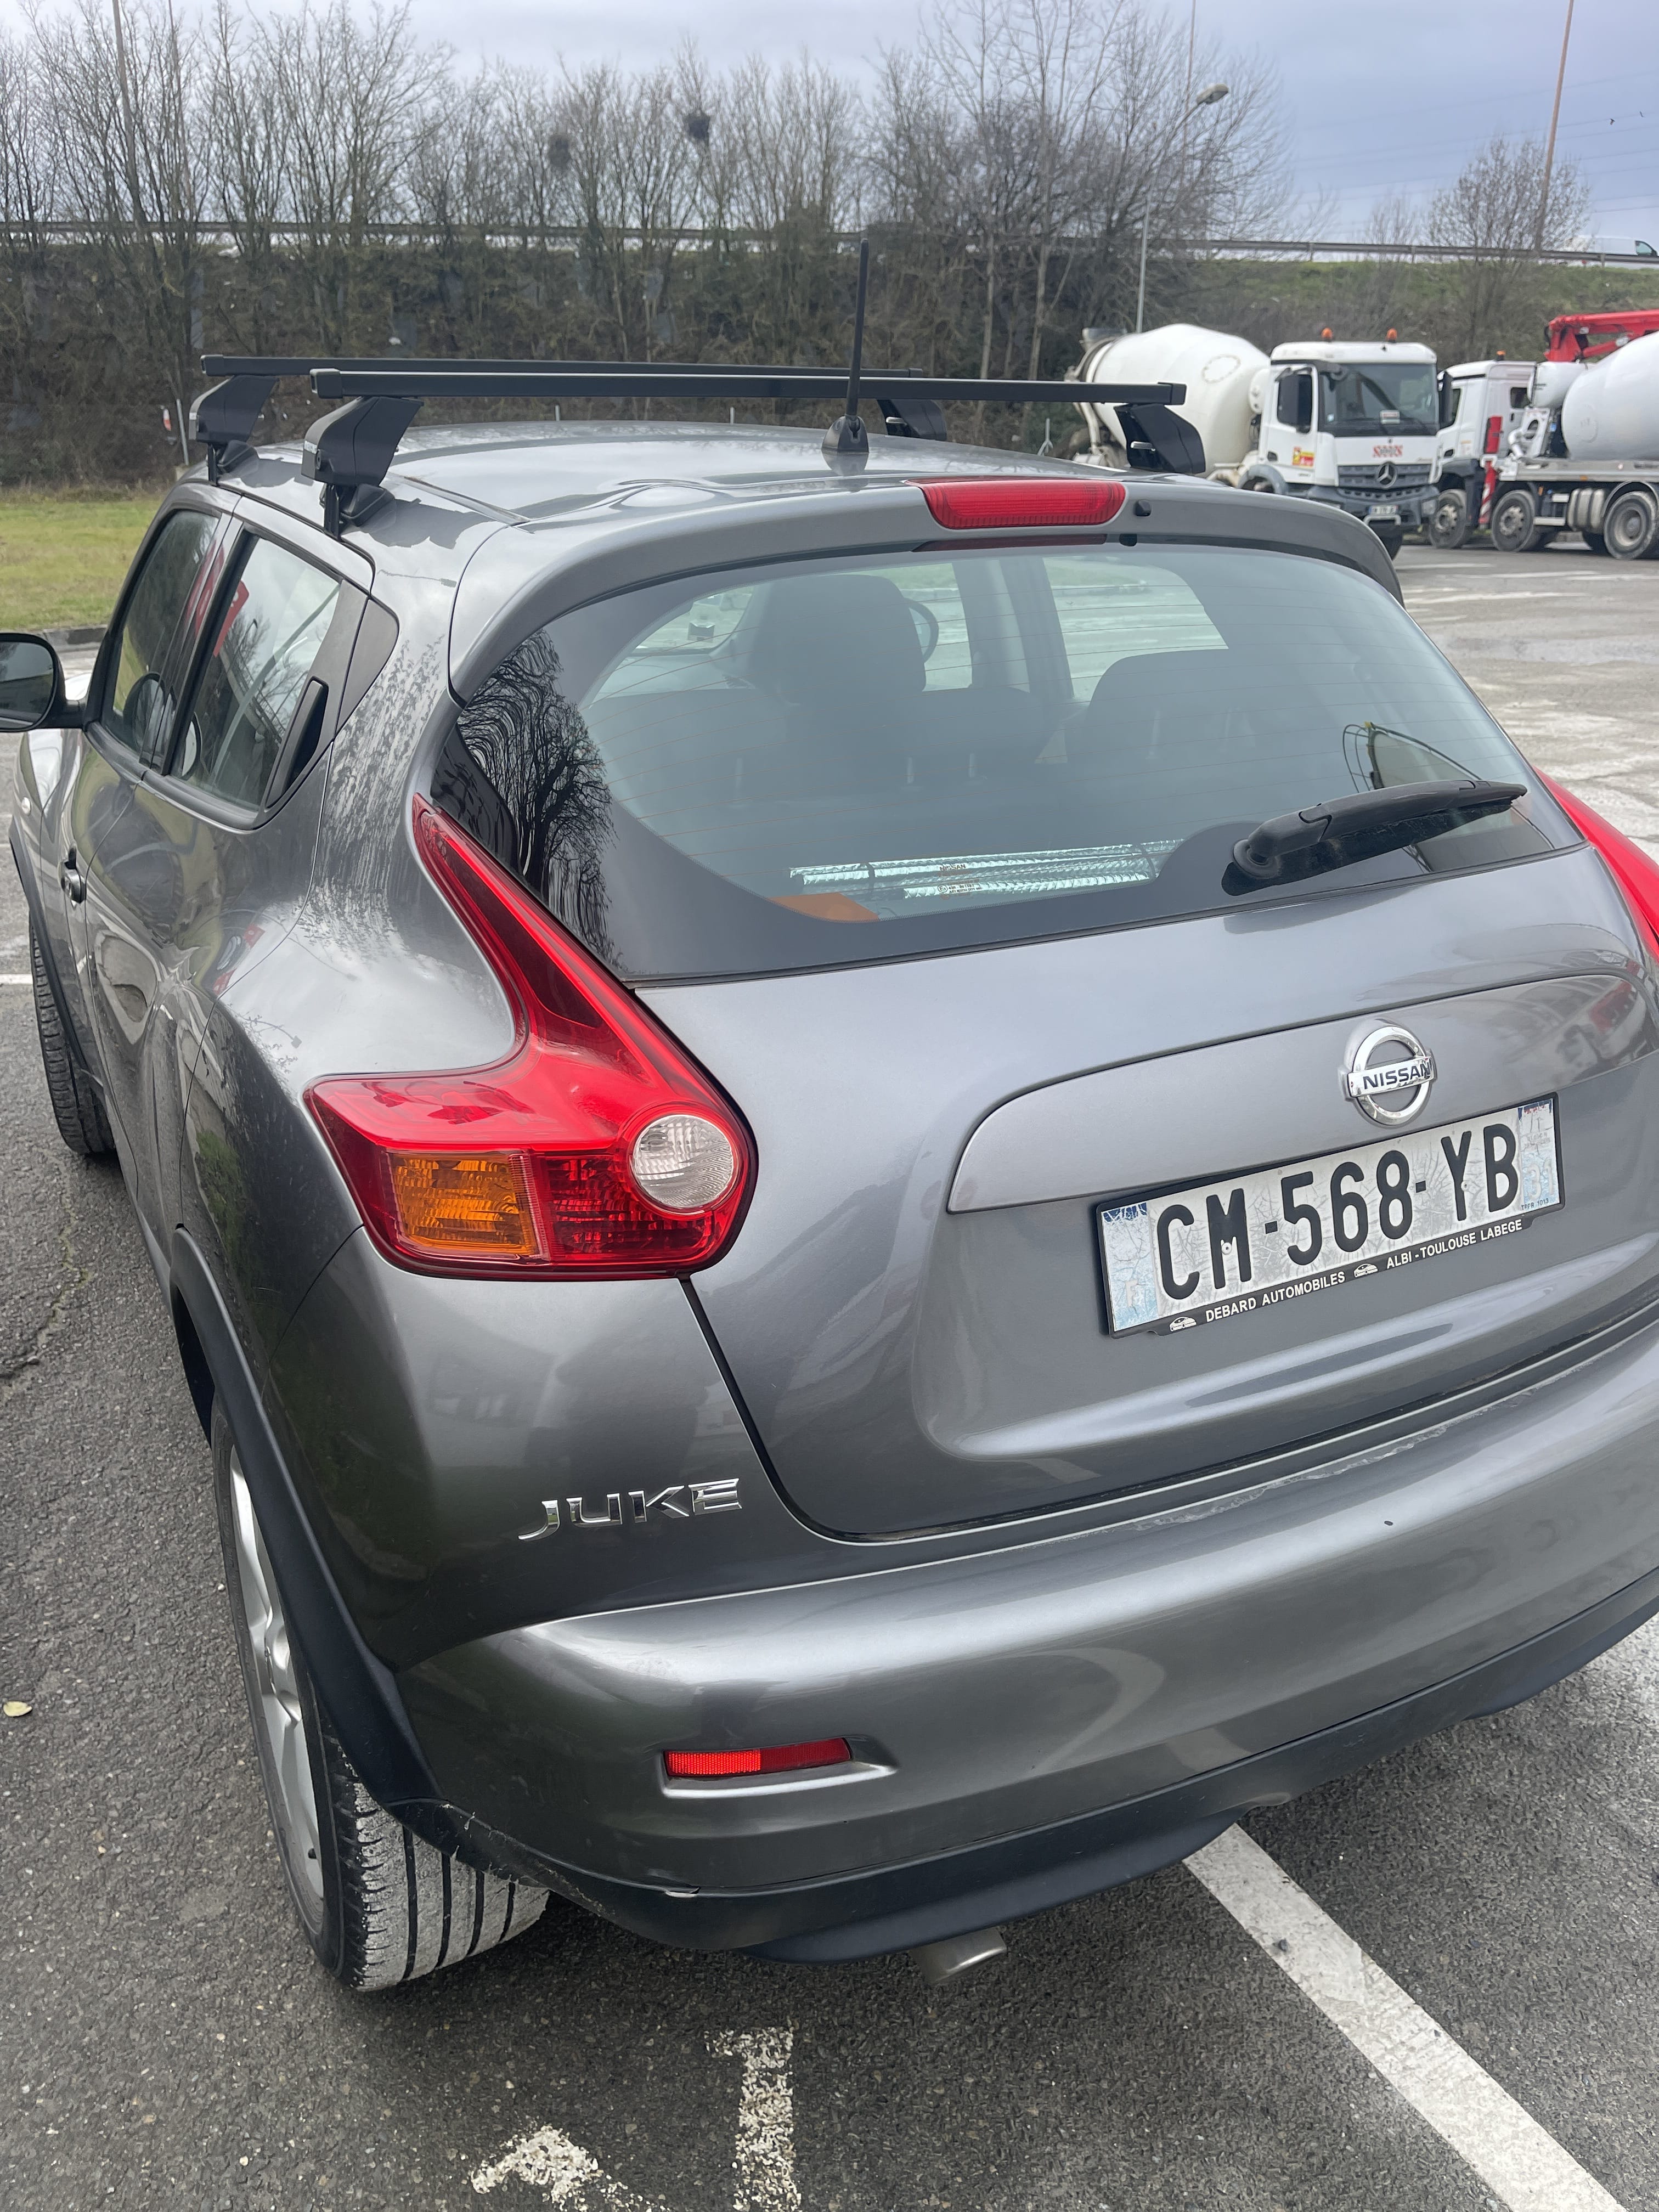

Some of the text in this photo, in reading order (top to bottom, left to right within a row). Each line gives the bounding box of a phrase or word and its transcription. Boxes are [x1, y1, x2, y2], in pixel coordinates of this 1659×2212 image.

[1363, 1058, 1432, 1090] NISSAN
[1157, 1124, 1519, 1300] CM-568-YB
[1537, 1198, 1549, 1206] 1013
[1386, 1251, 1412, 1269] ALBI
[1420, 1232, 1476, 1259] TOULOUSE
[1480, 1219, 1522, 1242] LABEGE
[1205, 1271, 1346, 1323] DEBARD AUTOMOBILES
[517, 1477, 743, 1542] JUKE
